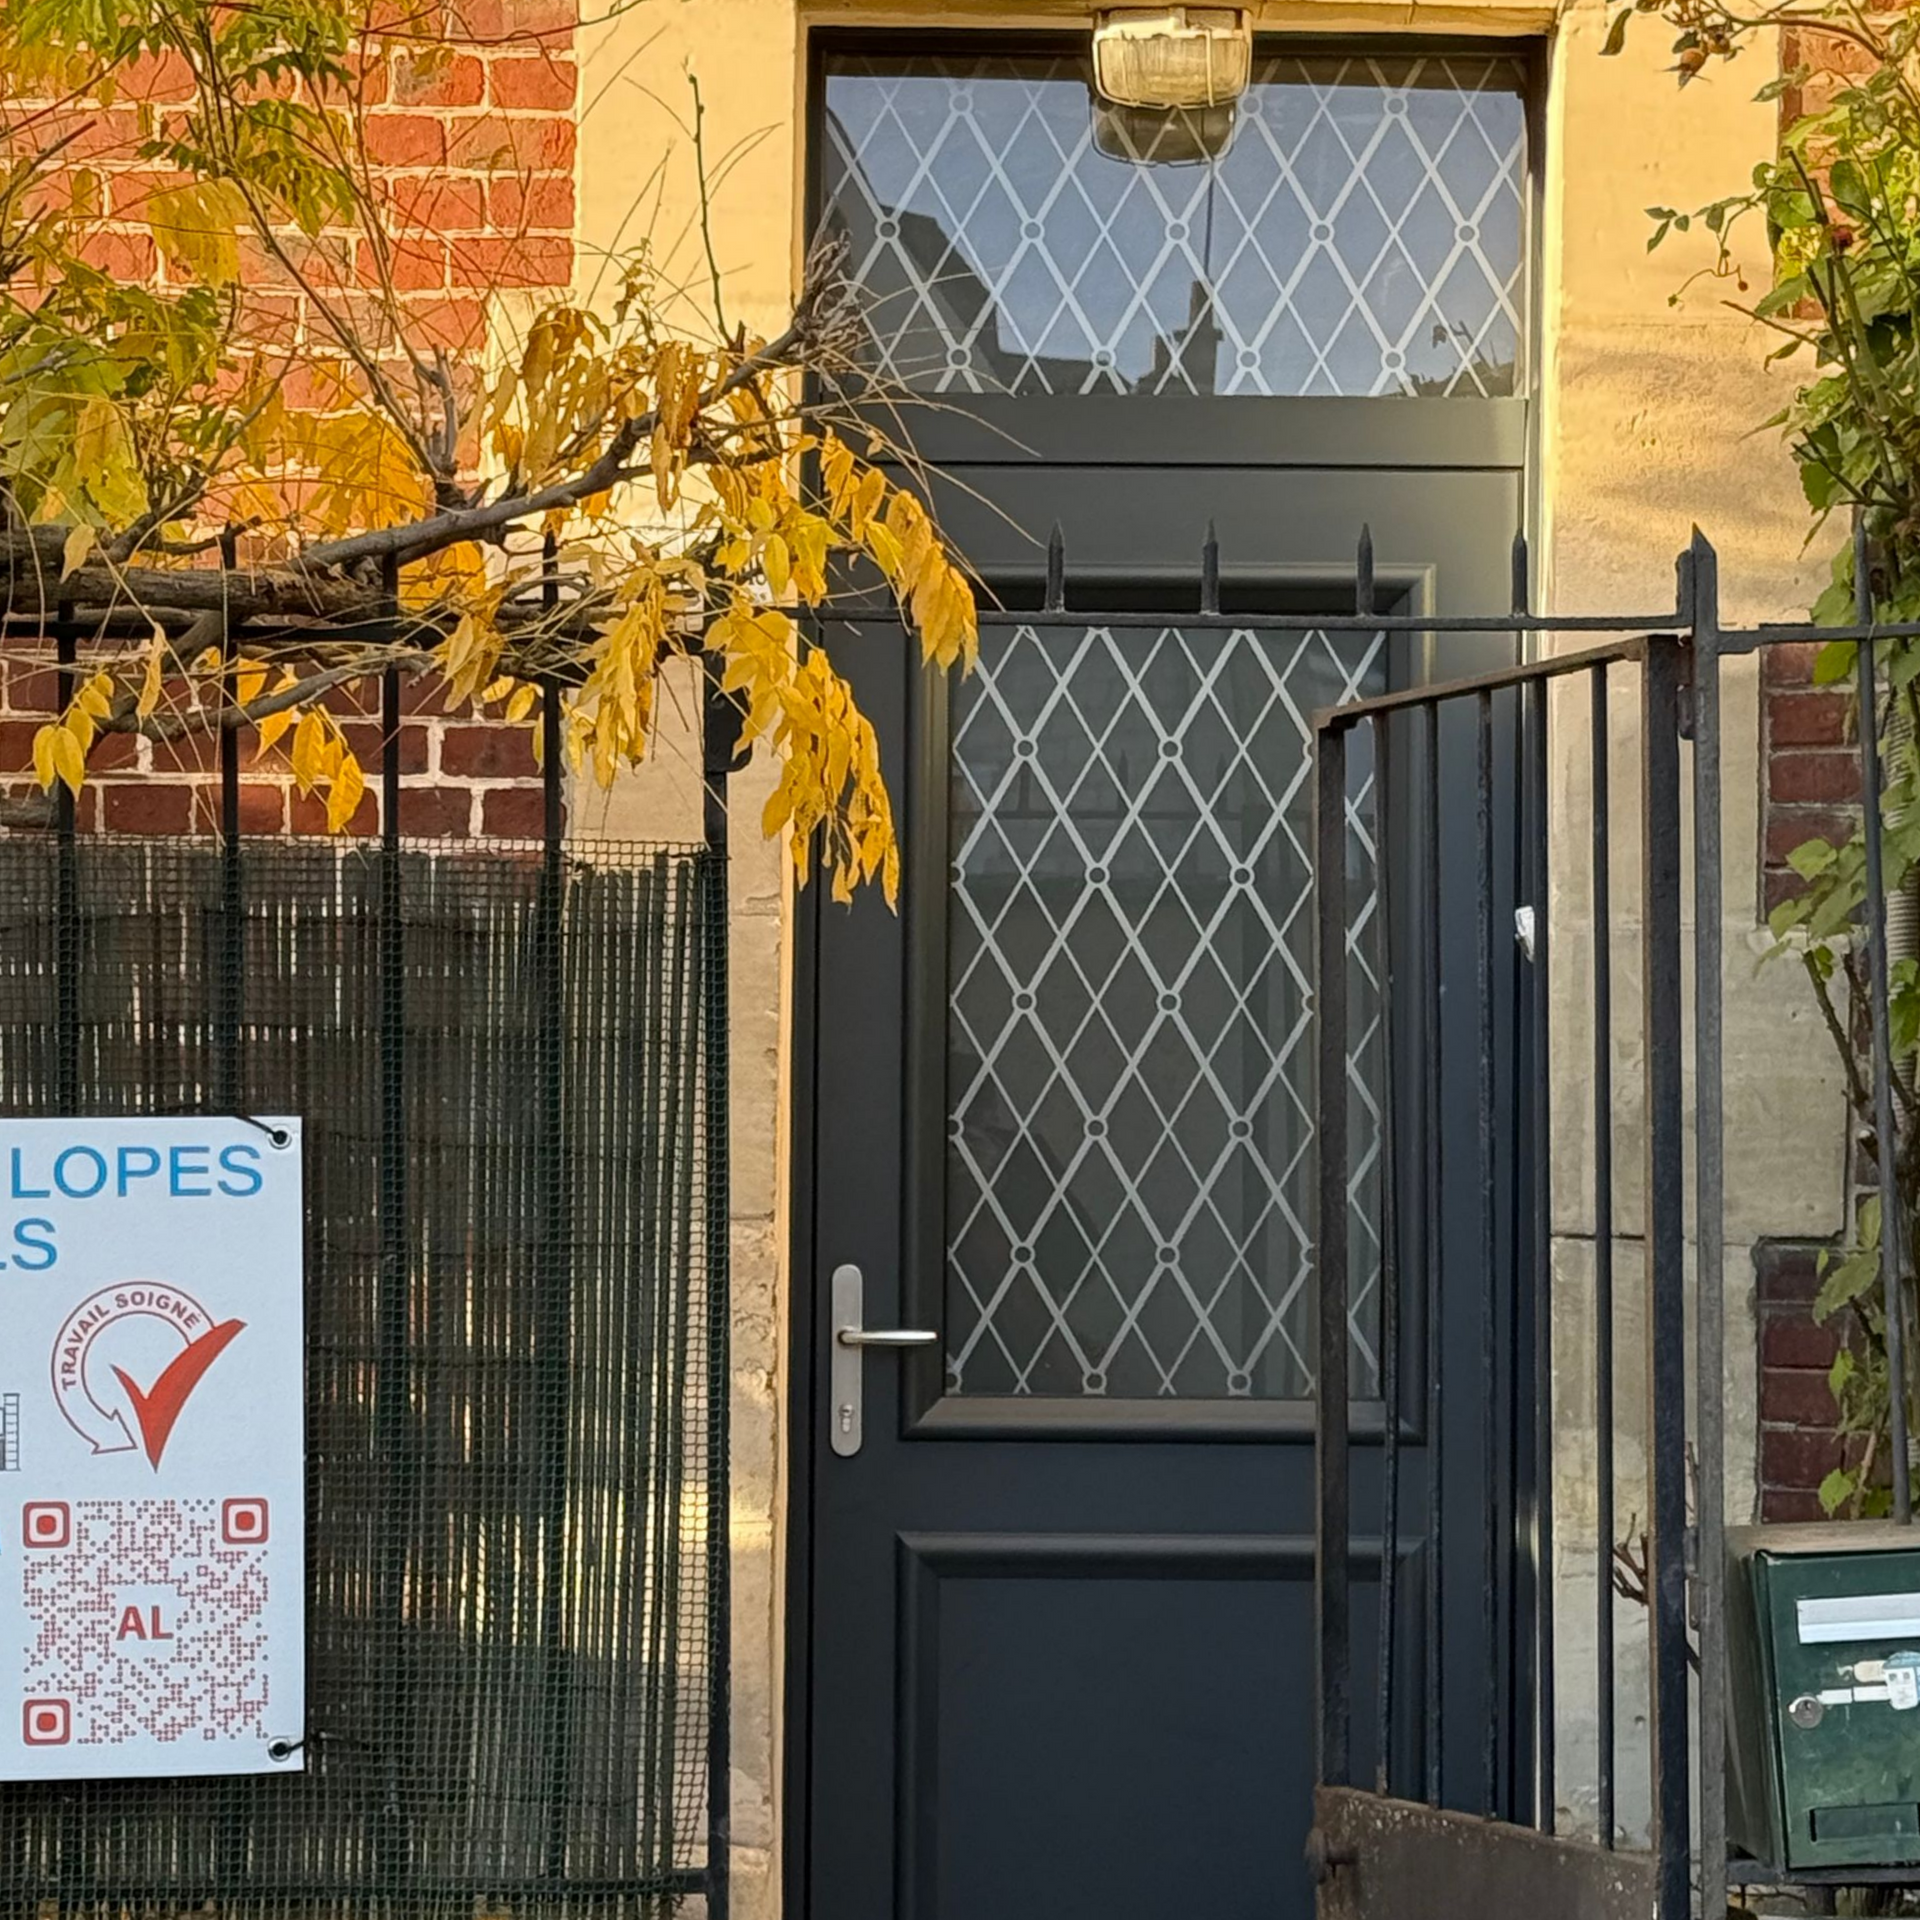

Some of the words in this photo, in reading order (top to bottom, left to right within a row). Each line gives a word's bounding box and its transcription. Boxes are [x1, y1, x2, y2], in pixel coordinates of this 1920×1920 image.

[11, 1145, 263, 1198] LOPES
[0, 1217, 57, 1271] S
[61, 1304, 110, 1391] TRAVAIL
[116, 1605, 174, 1640] AL
